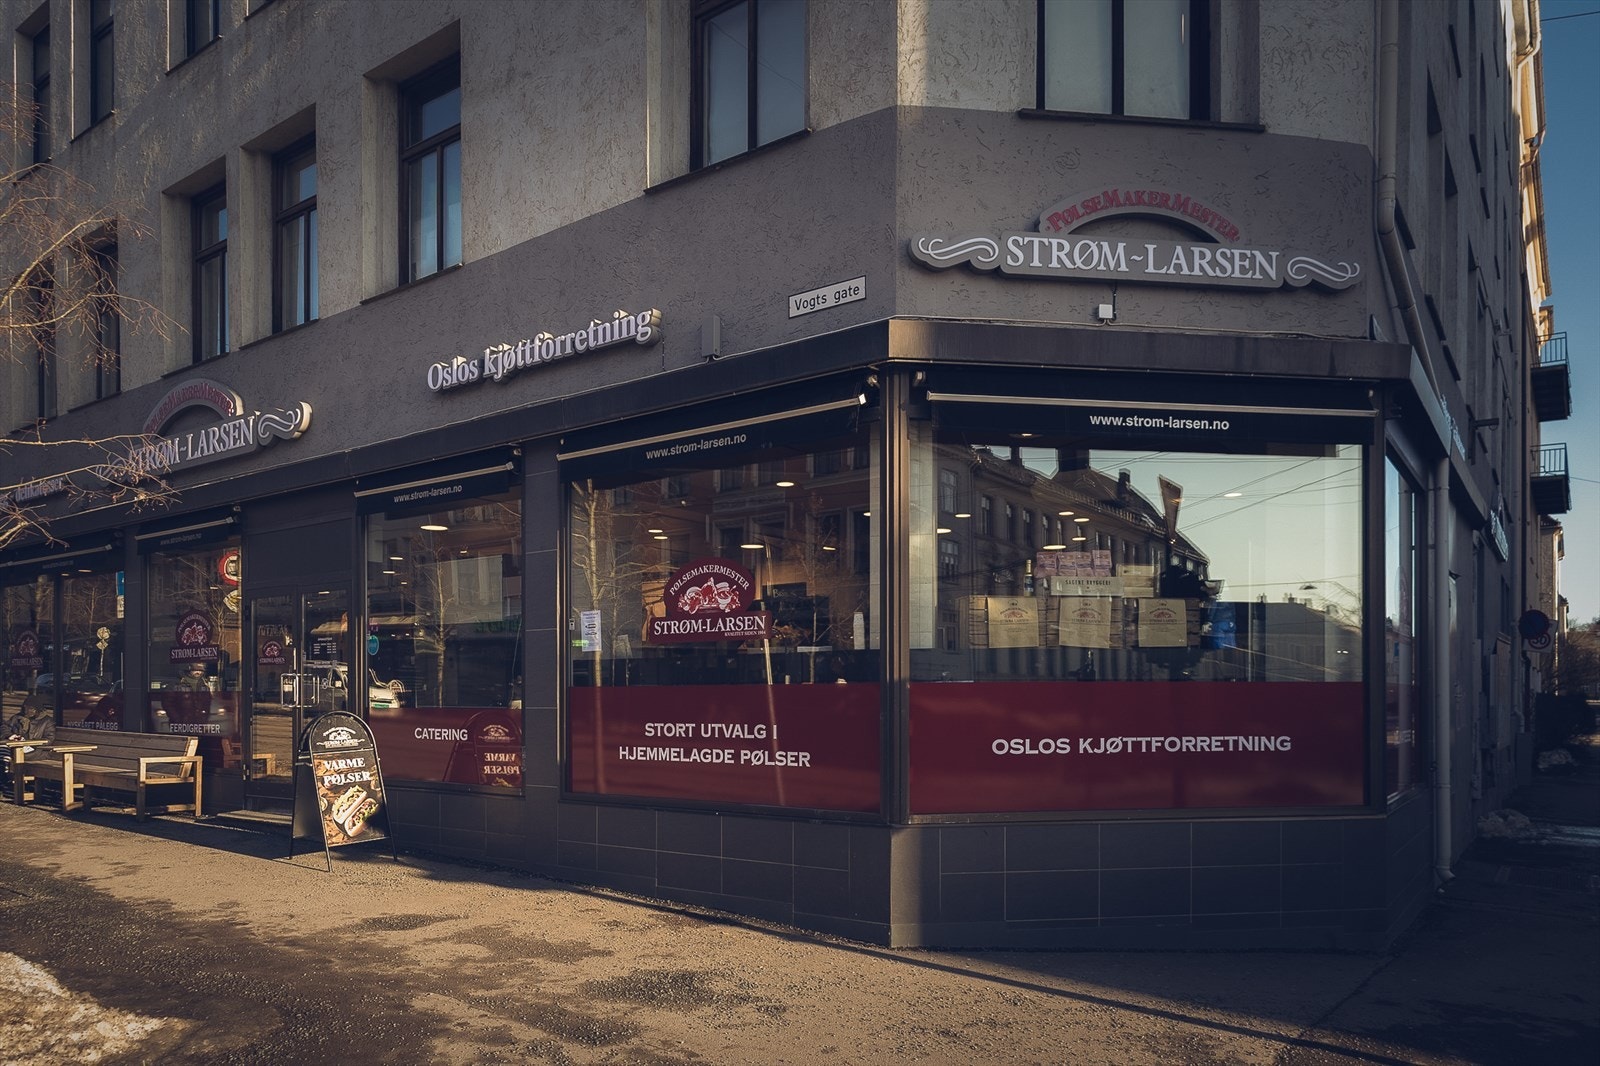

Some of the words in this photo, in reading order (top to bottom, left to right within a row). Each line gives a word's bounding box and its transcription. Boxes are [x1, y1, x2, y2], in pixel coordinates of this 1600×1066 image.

[794, 294, 827, 311] Vogts
[834, 285, 860, 304] gate
[427, 357, 479, 391] Oslos
[483, 309, 653, 381] kjøttforretning
[1089, 414, 1230, 431] www.strom-larsen.no
[645, 432, 747, 460] www.strom-larsen.no
[394, 483, 463, 504] www.strom-larsen.no
[669, 564, 750, 596] PØLSEMAKERMESTER
[654, 615, 767, 636] STRØM-LARSEN
[169, 723, 221, 734] FERDIGRETTER
[413, 727, 468, 742] CATERING
[645, 722, 696, 738] STORT
[700, 723, 767, 739] UTVALG
[991, 737, 1071, 755] OSLOS
[1079, 735, 1292, 755] KJØTTFORRETNING
[324, 757, 366, 771] VARME
[619, 745, 735, 764] HJEMMELAGDE
[740, 749, 811, 768] PØLSER
[323, 770, 371, 787] PØLSER
